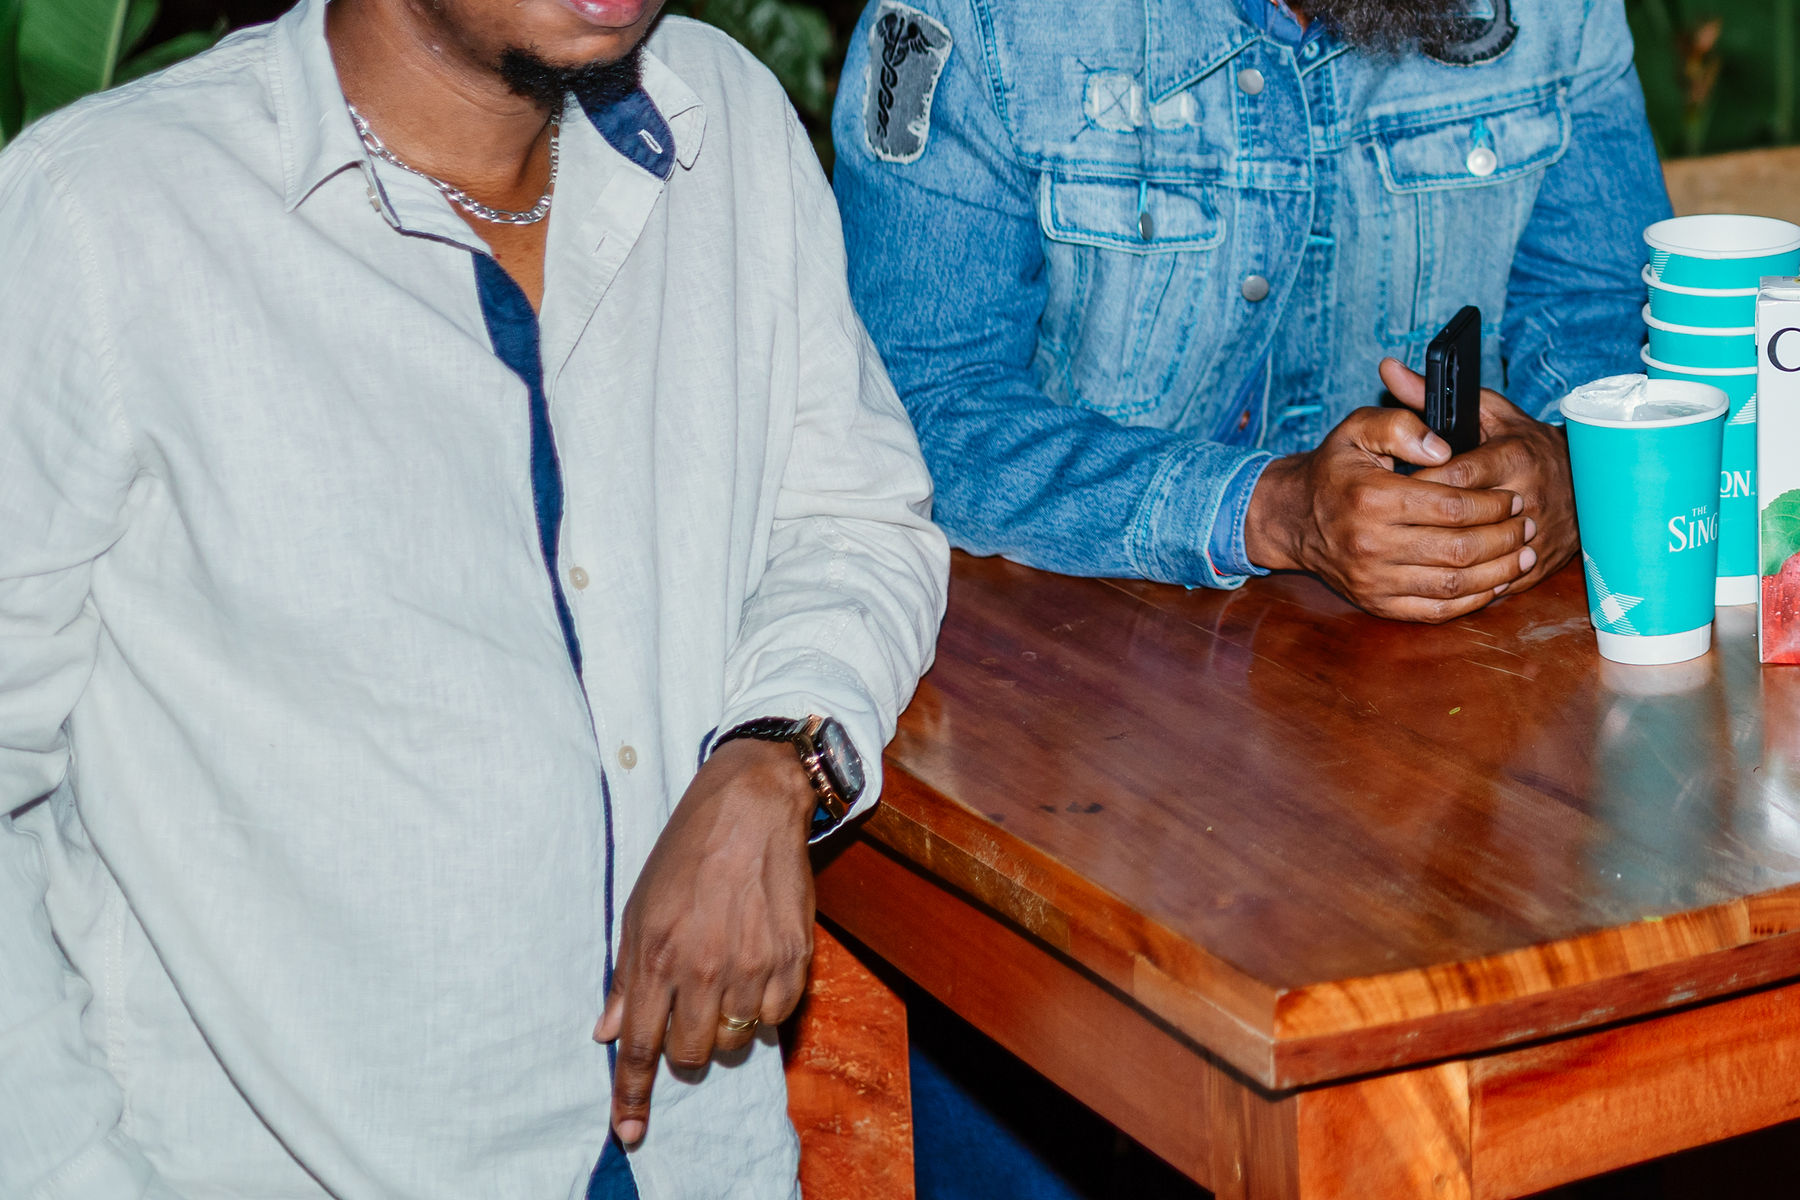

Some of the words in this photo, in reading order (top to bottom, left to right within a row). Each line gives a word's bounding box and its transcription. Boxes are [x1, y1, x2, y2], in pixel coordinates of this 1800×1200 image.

[1720, 470, 1751, 498] ON
[1692, 505, 1707, 517] THE
[1668, 512, 1718, 553] SING
